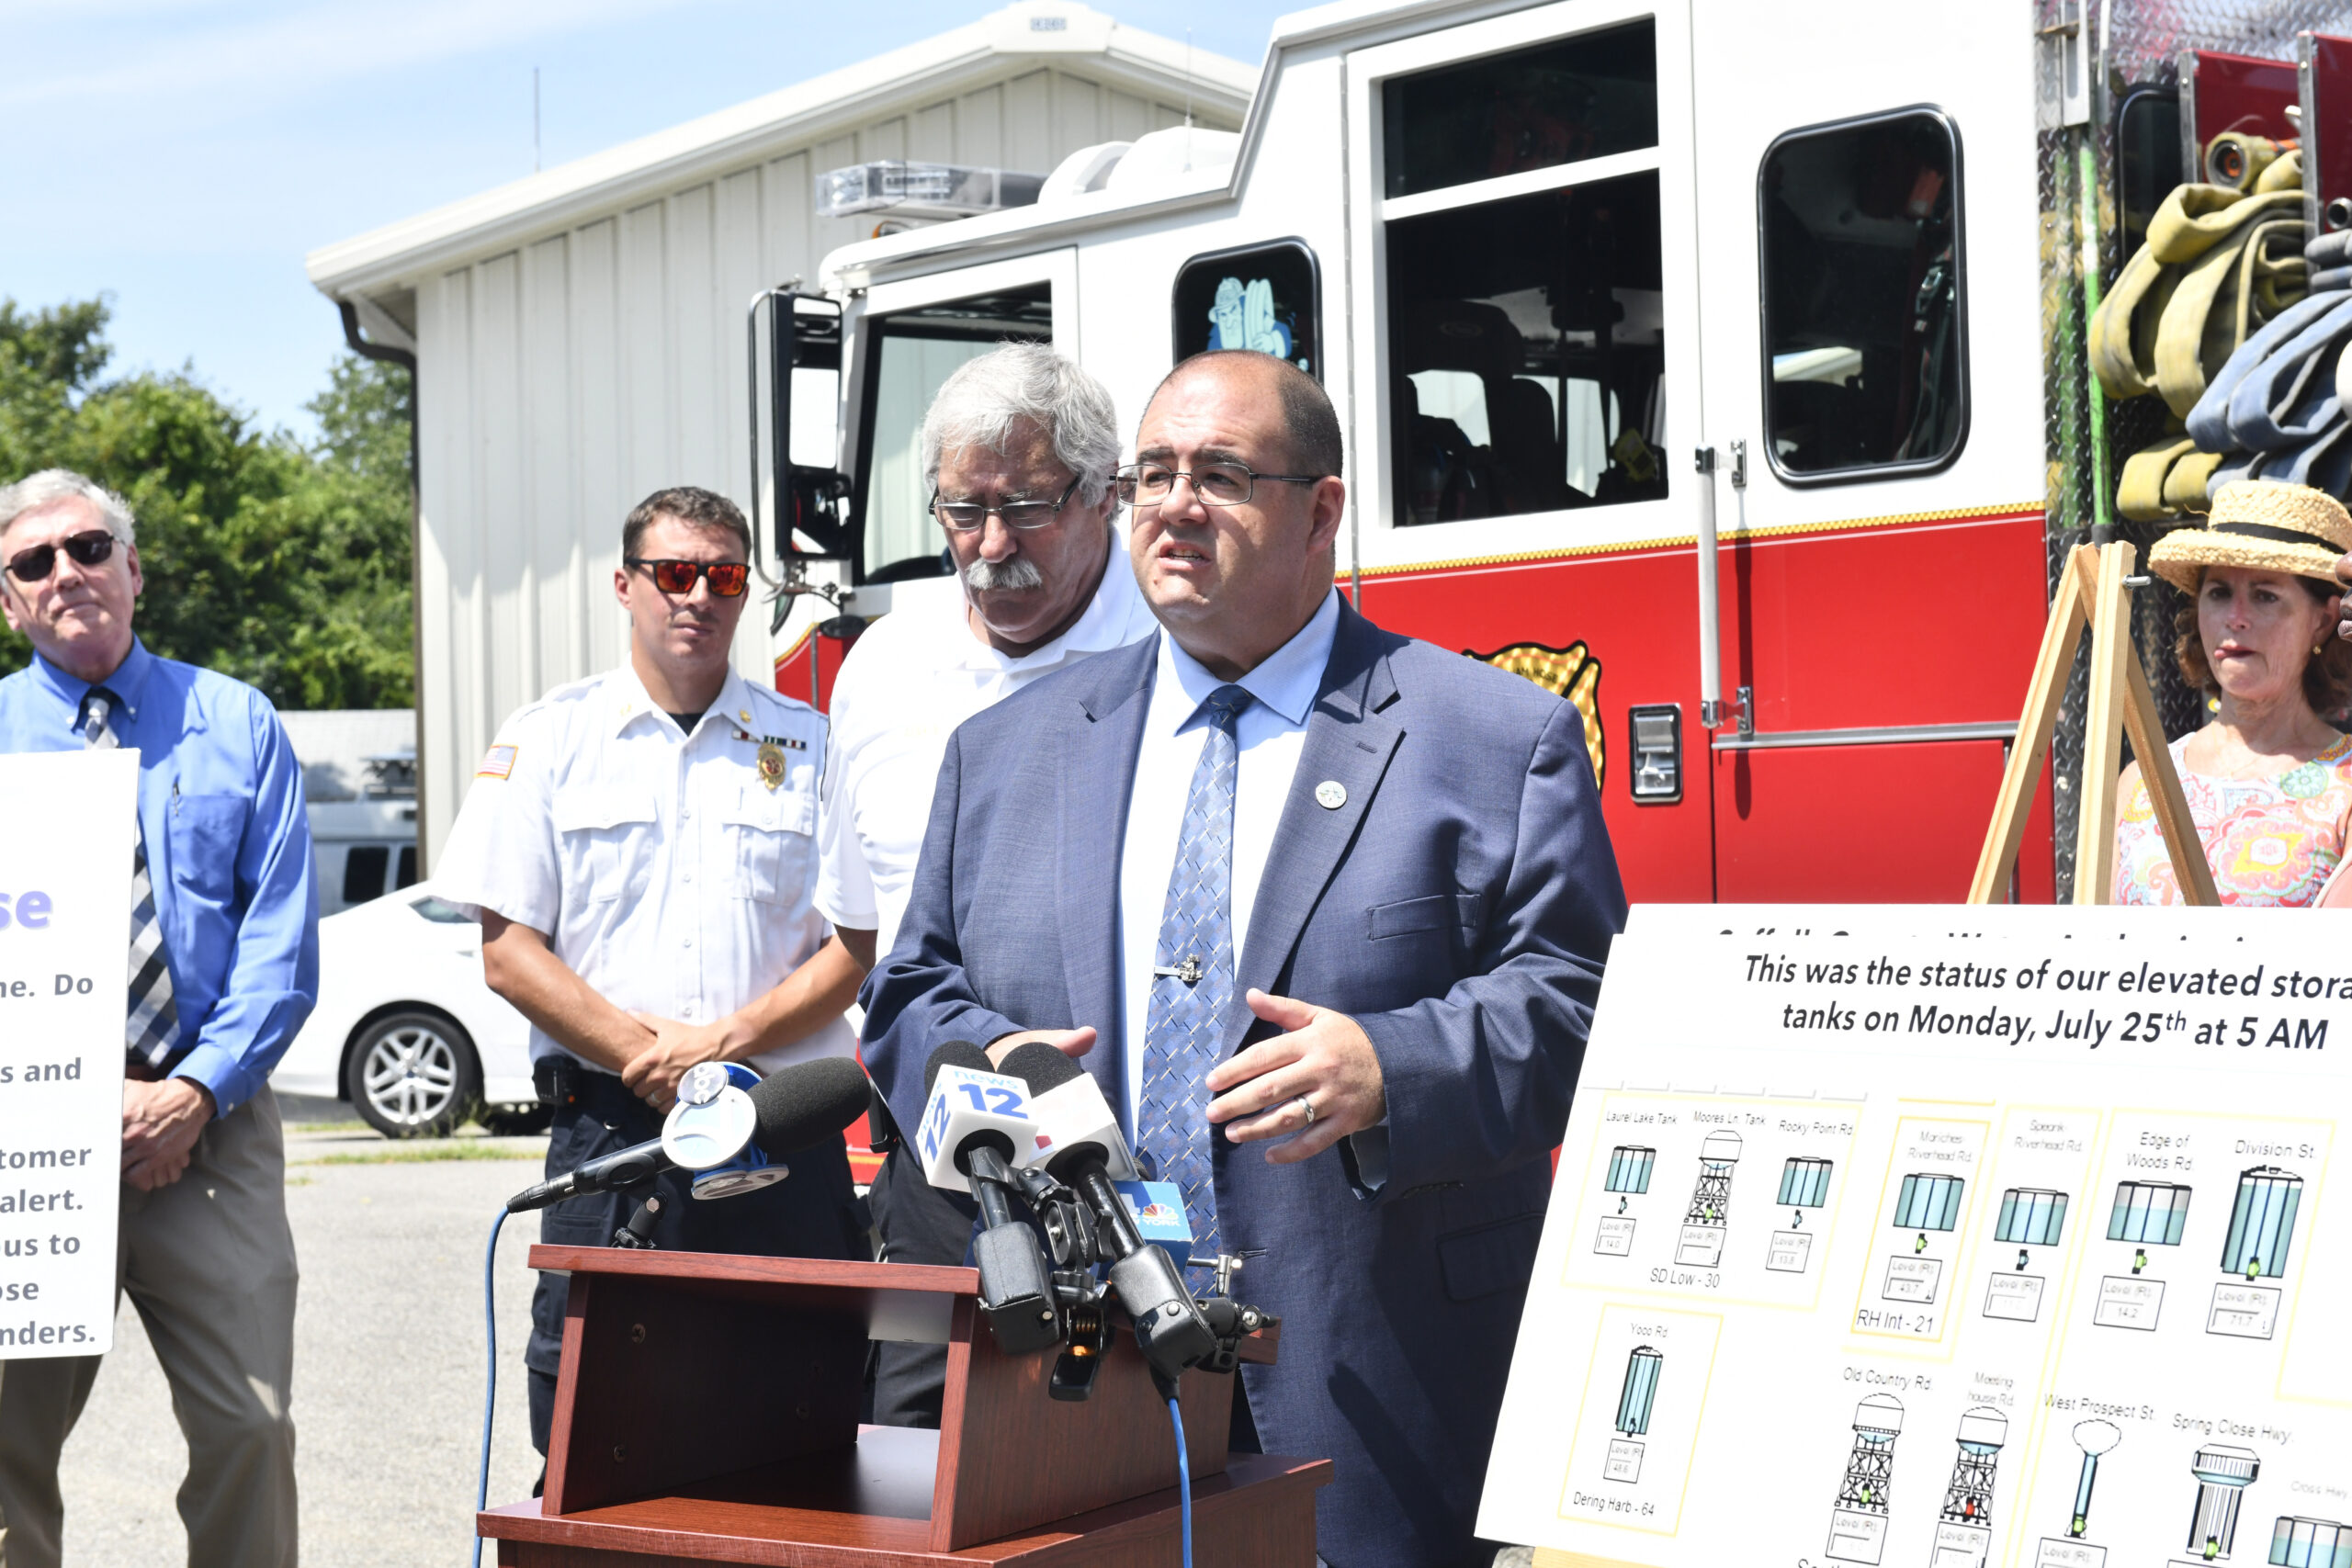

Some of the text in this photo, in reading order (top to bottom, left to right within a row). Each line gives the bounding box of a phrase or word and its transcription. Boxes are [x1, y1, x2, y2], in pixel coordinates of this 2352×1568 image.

[55, 975, 93, 995] Do
[1747, 953, 1797, 983] This
[1806, 964, 1859, 984] was
[1867, 956, 1911, 986] the
[1919, 962, 2007, 988] status
[2017, 959, 2051, 988] of
[2057, 970, 2110, 990] our
[2119, 962, 2264, 996] elevated
[1783, 1001, 2328, 1049] tanks on Monday, July 25th at 5 AM
[25, 1057, 81, 1082] and
[954, 1070, 1018, 1089] news
[694, 1065, 718, 1104] abc
[957, 1083, 1029, 1120] 12
[924, 1093, 952, 1163] 12
[1606, 1111, 1677, 1124] Laurel Lake Tank
[1693, 1111, 1724, 1123] Moores
[1746, 1113, 1766, 1125] Tank
[1813, 1122, 1837, 1134] Point
[2140, 1132, 2190, 1150] Edge of
[2234, 1140, 2292, 1156] Division
[2127, 1154, 2168, 1168] Woods
[0, 1190, 83, 1213] alert.
[1144, 1219, 1182, 1227] YORK
[49, 1235, 80, 1255] to
[1650, 1268, 1668, 1283] SD
[1670, 1270, 1695, 1285] Low
[1704, 1273, 1720, 1288] 30
[0, 1283, 39, 1301] se
[1857, 1309, 1882, 1327] RH
[1884, 1313, 1903, 1330] Int
[1915, 1315, 1933, 1333] 21
[1843, 1367, 1862, 1382] Old
[1866, 1370, 1911, 1391] Country
[2045, 1393, 2075, 1410] West
[2080, 1397, 2135, 1419] Prospect
[2173, 1413, 2212, 1436] Spring
[2218, 1419, 2256, 1438] Close
[1574, 1492, 1605, 1512] Dering
[1608, 1497, 1632, 1513] Harb
[1642, 1502, 1654, 1516] 64
